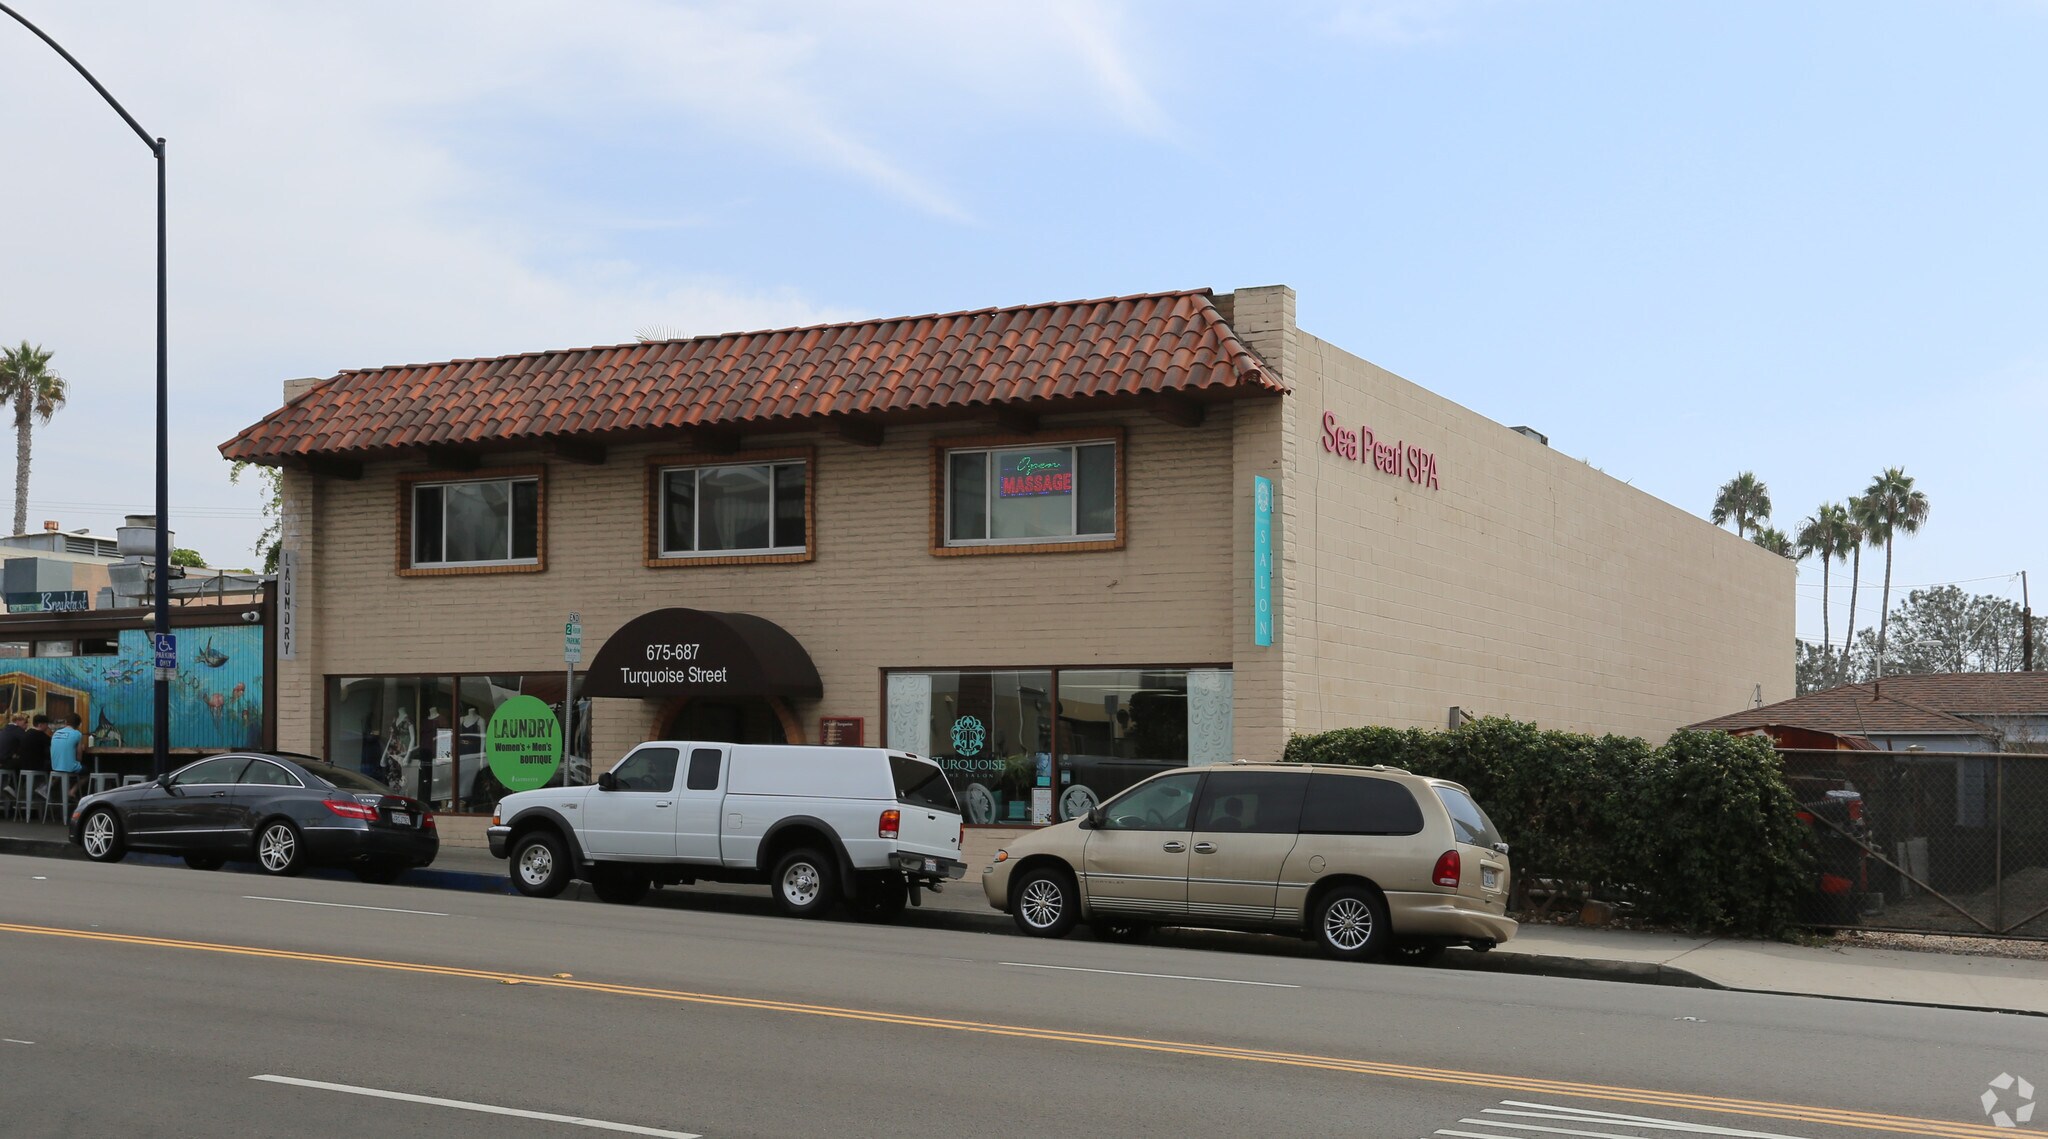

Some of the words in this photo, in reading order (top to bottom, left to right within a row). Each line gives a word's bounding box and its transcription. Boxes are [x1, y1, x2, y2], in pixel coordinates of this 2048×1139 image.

[1322, 410, 1358, 461] Sea
[1361, 425, 1404, 478] Pearl
[1407, 444, 1439, 491] SPA
[1016, 456, 1060, 476] Open
[1003, 472, 1073, 494] MASSAGE
[1259, 529, 1268, 635] SALON
[41, 591, 87, 611] Breakfast
[156, 651, 176, 659] PARKING
[646, 643, 700, 661] 675-687
[620, 667, 685, 687] Turquoise
[688, 666, 727, 682] Street
[494, 718, 554, 738] LAUNDRY
[495, 742, 526, 752] Women's
[532, 742, 552, 752] Men's
[520, 755, 552, 765] BOUTIQUE
[932, 756, 1007, 773] TURQUOISE
